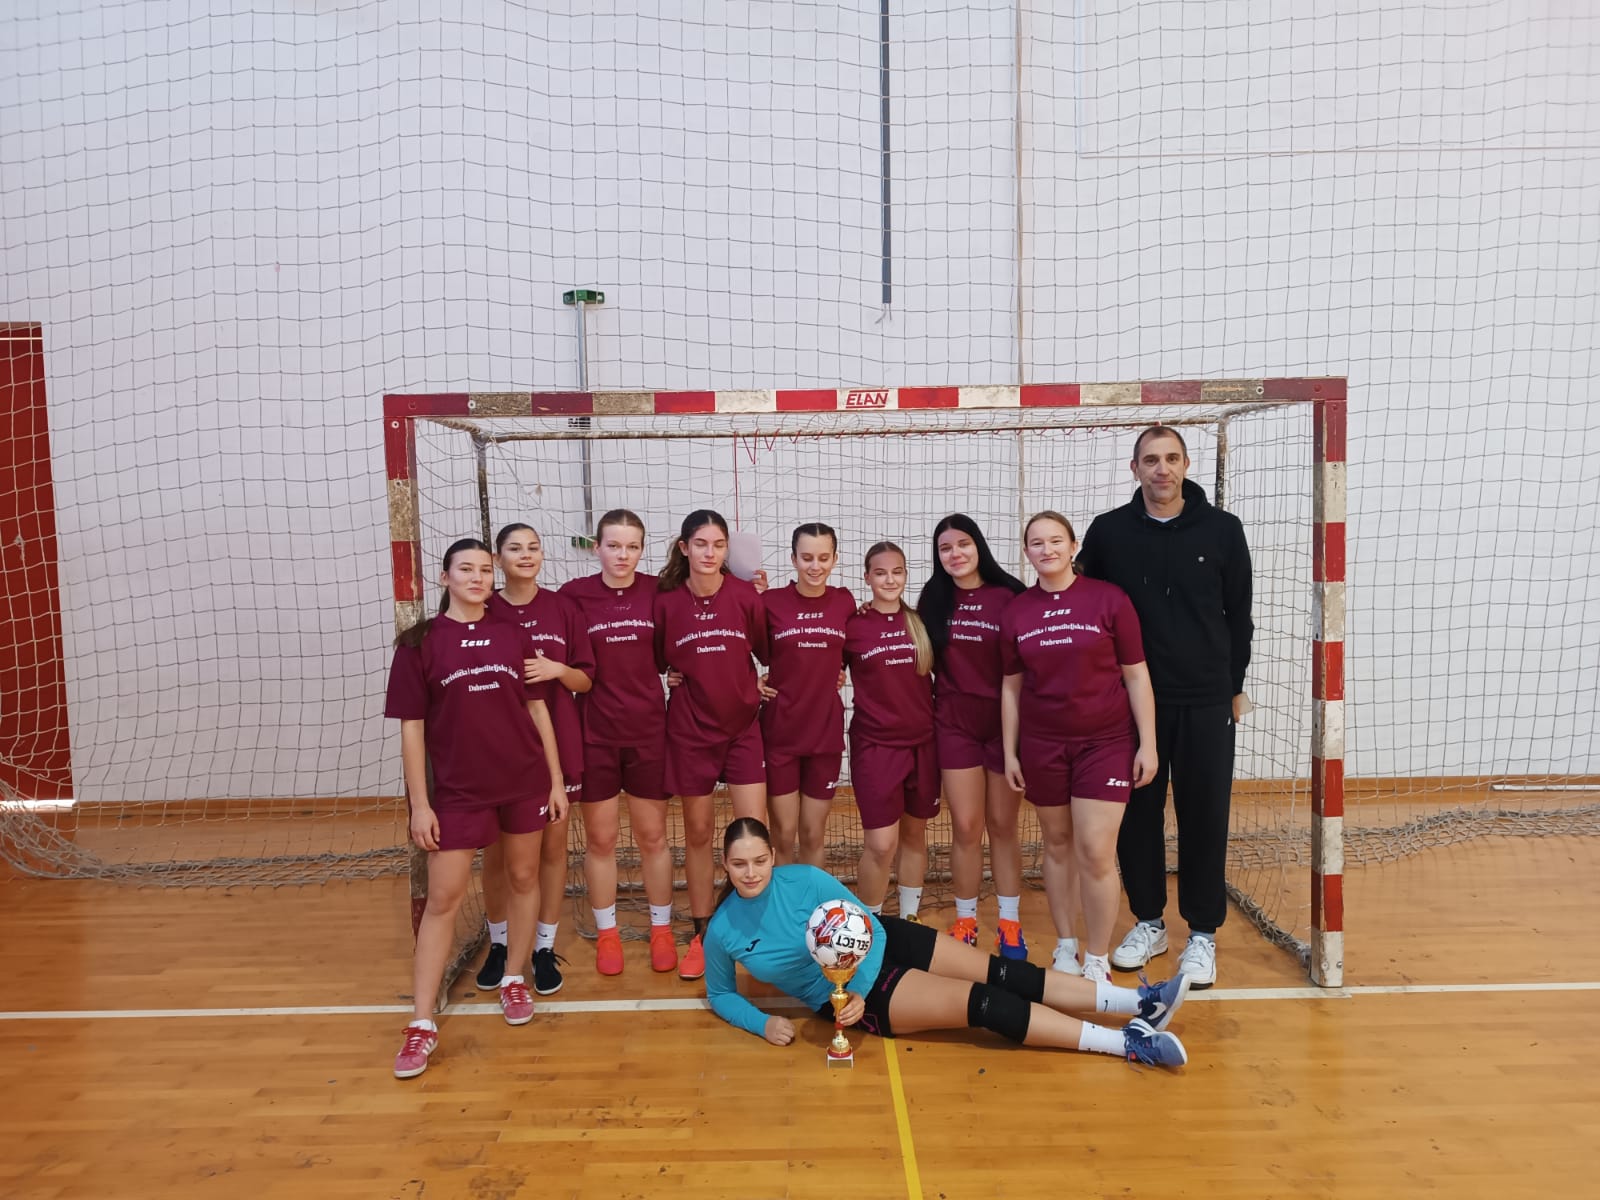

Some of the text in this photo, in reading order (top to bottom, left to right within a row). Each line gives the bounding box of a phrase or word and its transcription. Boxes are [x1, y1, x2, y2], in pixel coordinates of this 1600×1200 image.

[846, 393, 888, 405] ELAN
[796, 612, 824, 620] Zeus
[1042, 608, 1072, 619] Zeus
[1048, 623, 1084, 632] ugostiteljska
[606, 634, 637, 643] Dubrovnik
[880, 630, 906, 638] Zeus
[953, 633, 983, 642] Dubrovnik
[461, 639, 490, 647] Zeus
[1040, 637, 1073, 646] Dubrovnik
[697, 644, 726, 653] Dubrovnik
[885, 657, 913, 666] Dubrovnik
[471, 664, 507, 675] ugostiteljska
[468, 681, 500, 692] Dubrovnik
[836, 935, 870, 951] SELECT
